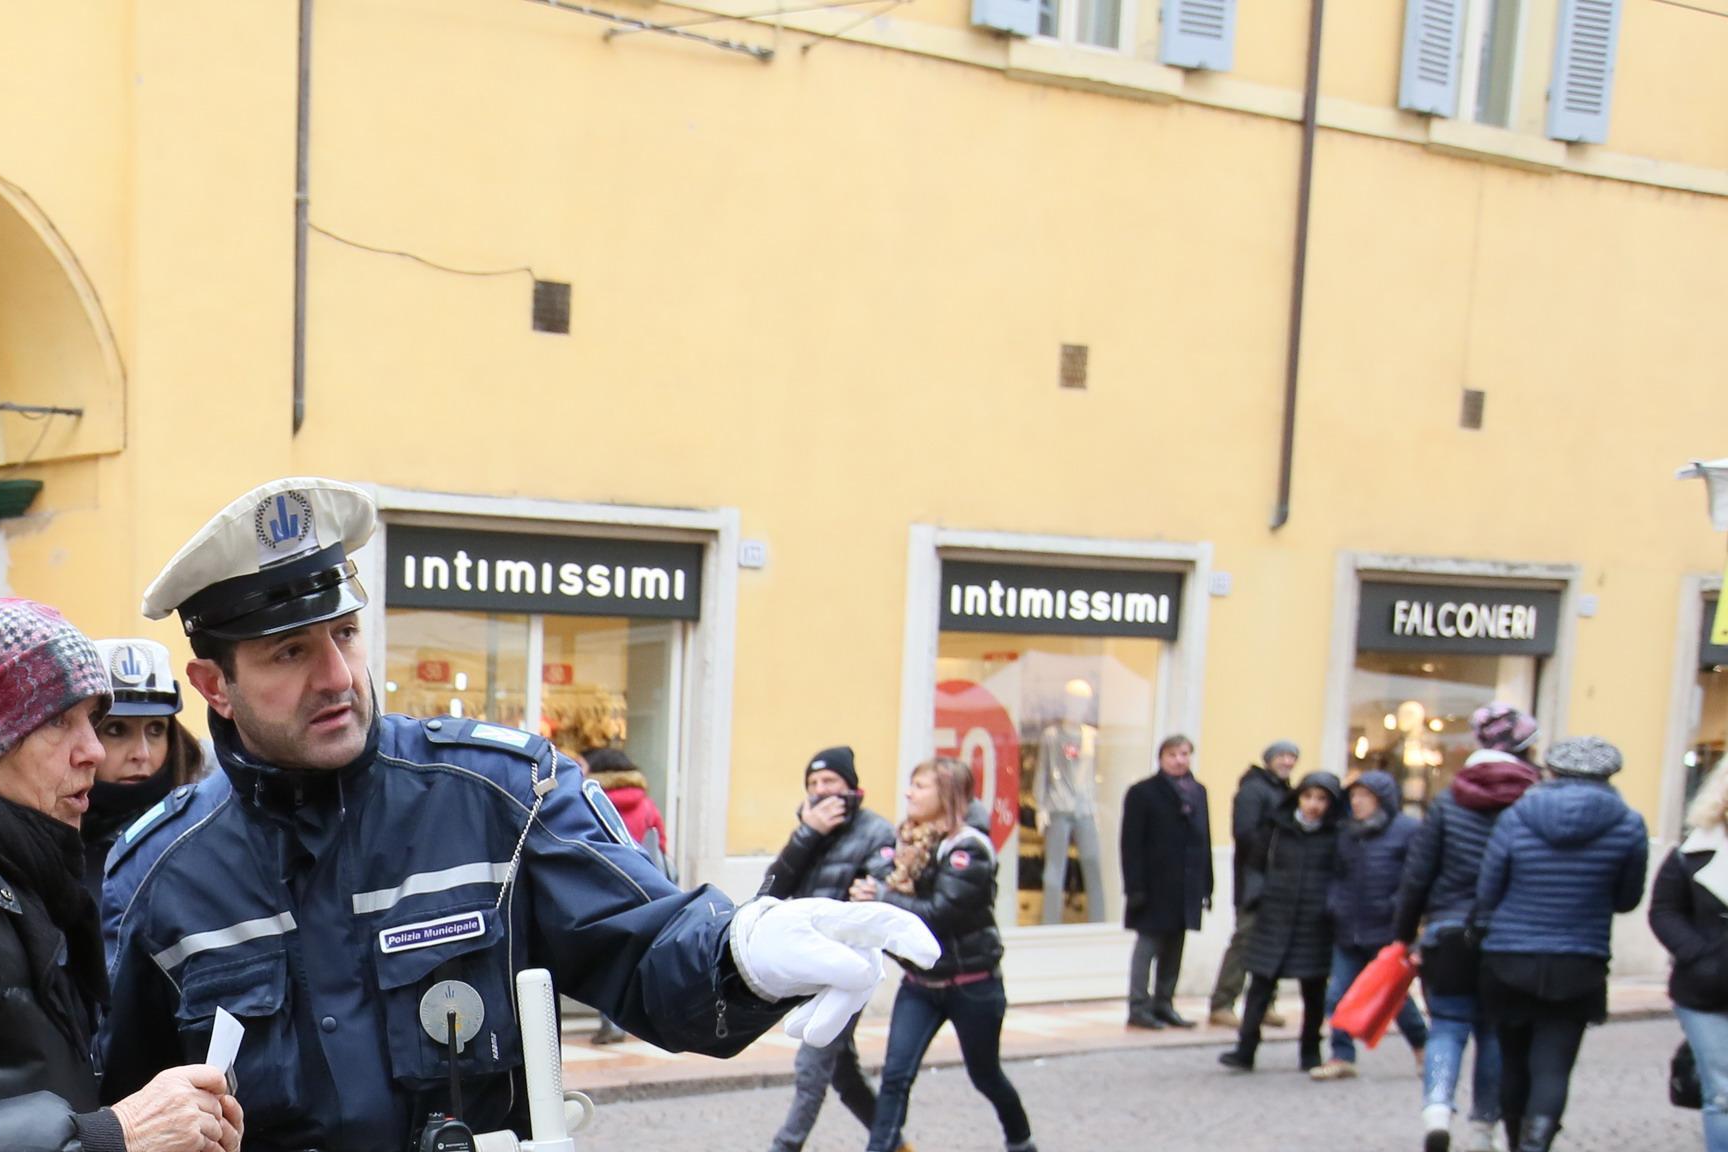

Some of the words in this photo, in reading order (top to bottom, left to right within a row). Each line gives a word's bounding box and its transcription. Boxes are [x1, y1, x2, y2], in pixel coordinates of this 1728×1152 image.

[404, 550, 685, 601] intimissimi
[950, 579, 1170, 624] intimissimi
[1393, 600, 1537, 640] FALCONERI
[388, 930, 421, 945] Polizia
[424, 921, 478, 939] Municipale
